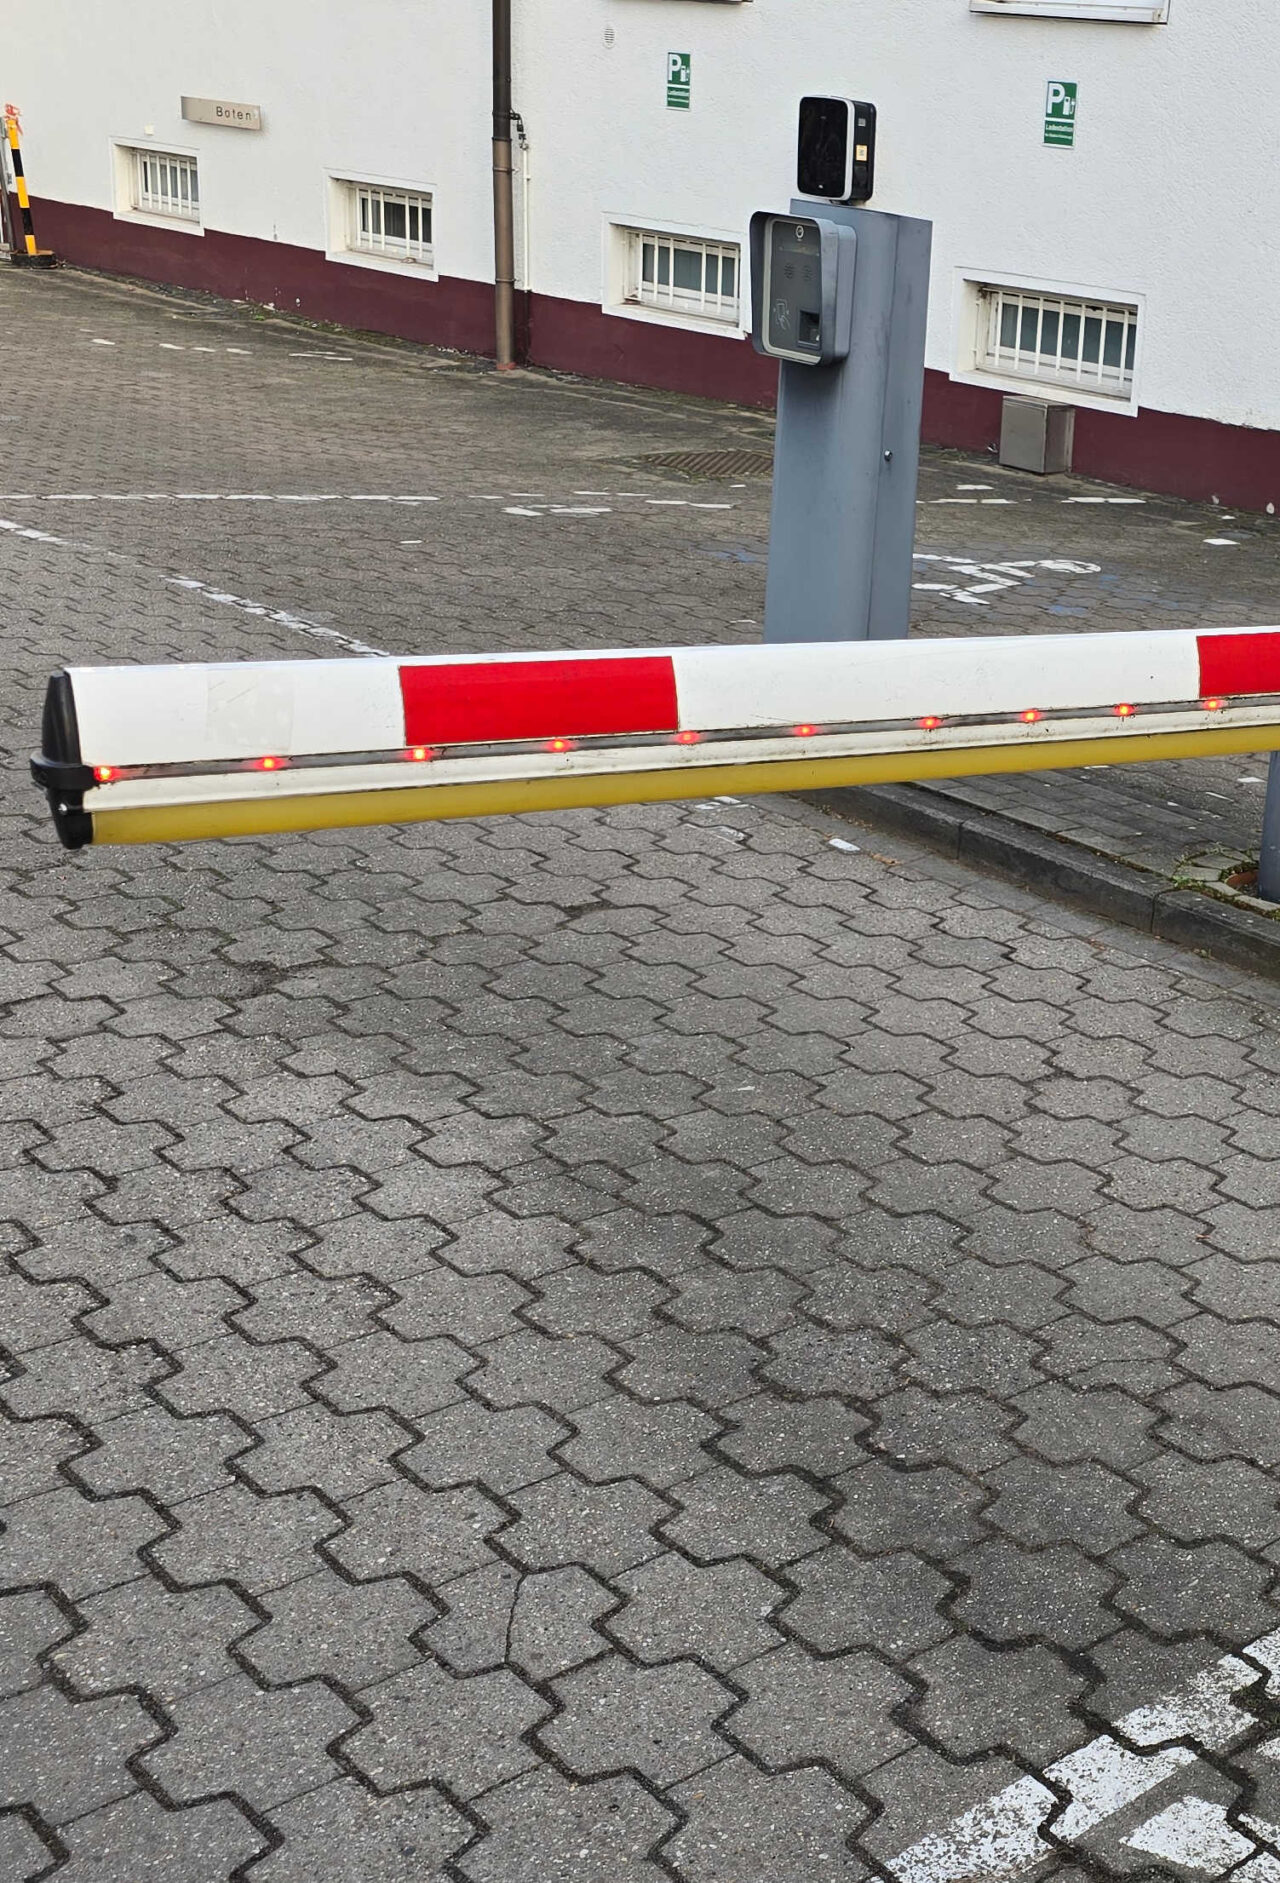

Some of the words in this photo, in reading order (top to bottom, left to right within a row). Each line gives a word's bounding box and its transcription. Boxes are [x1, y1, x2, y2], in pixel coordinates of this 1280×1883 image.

[669, 54, 682, 81] P
[1047, 82, 1066, 114] P
[215, 106, 252, 121] Boten
